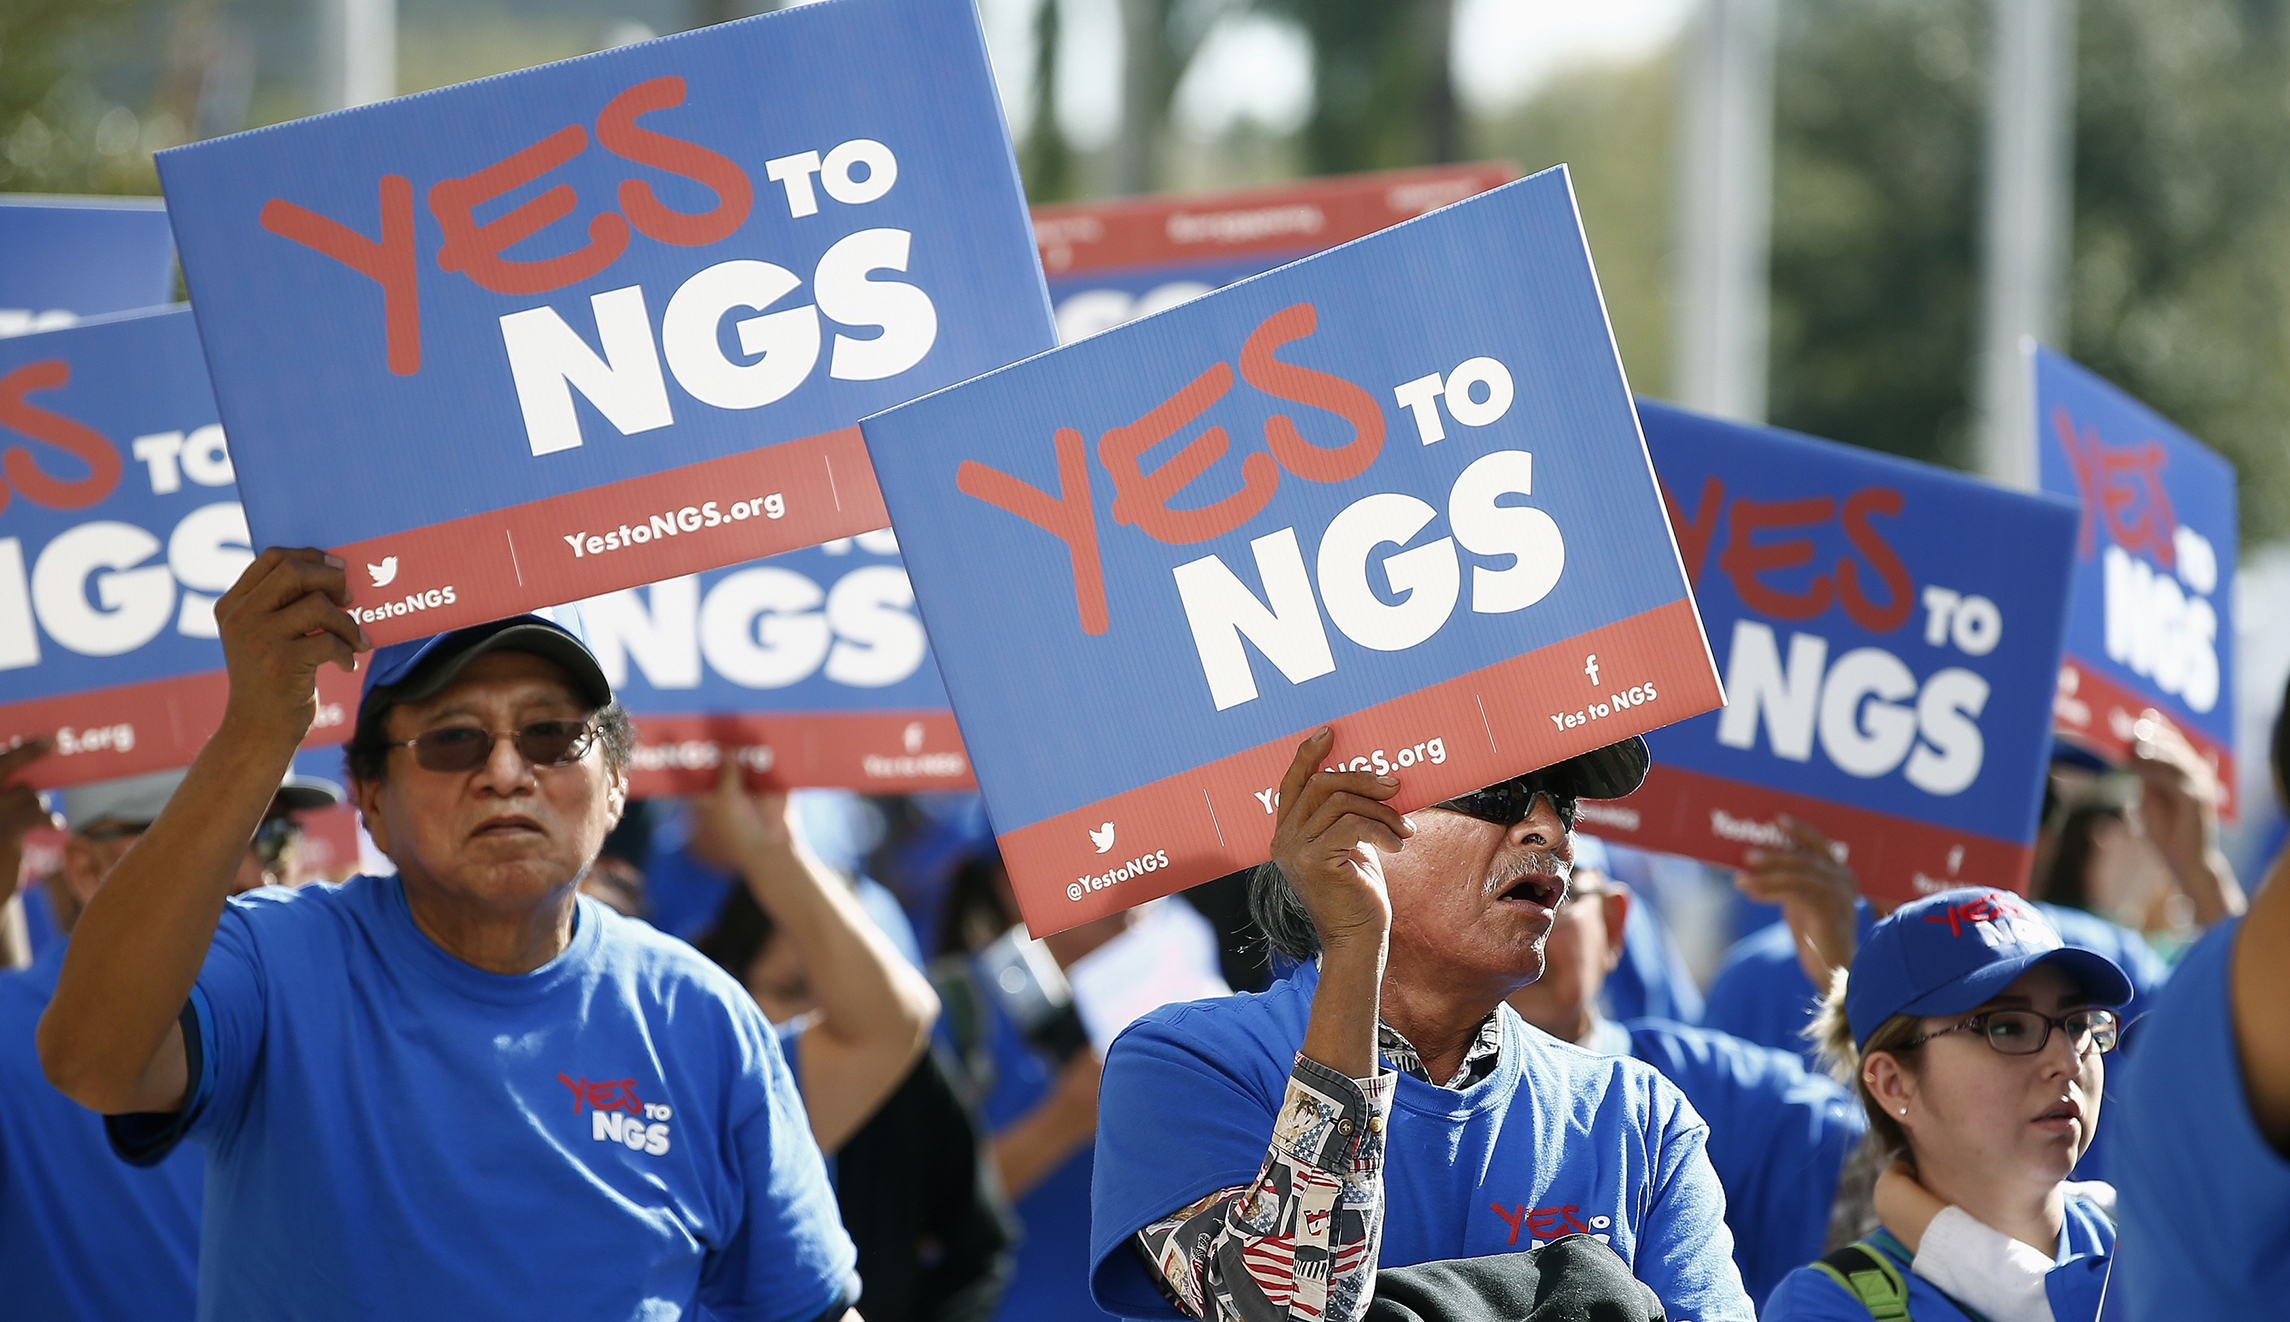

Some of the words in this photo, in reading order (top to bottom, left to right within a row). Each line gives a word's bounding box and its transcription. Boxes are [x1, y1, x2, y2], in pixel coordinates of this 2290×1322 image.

[766, 138, 898, 218] TO
[259, 76, 754, 376] YES
[499, 228, 938, 457] NGS
[1394, 356, 1515, 446] TO
[133, 423, 236, 495] TO
[955, 303, 1386, 636] YES
[564, 492, 787, 559] YestoNGS.org
[0, 501, 257, 672] GS
[1173, 450, 1566, 712] NGS
[1922, 584, 2002, 656] TO
[578, 565, 928, 690] NGS
[1550, 711, 1587, 731] Yes
[1588, 703, 1610, 720] to
[1610, 681, 1658, 712] NGS
[1717, 619, 1991, 797] NGS
[1066, 849, 1170, 901] @YestoNGS
[557, 1072, 642, 1116] YES
[591, 1109, 671, 1156] NGS
[643, 1102, 673, 1121] TO
